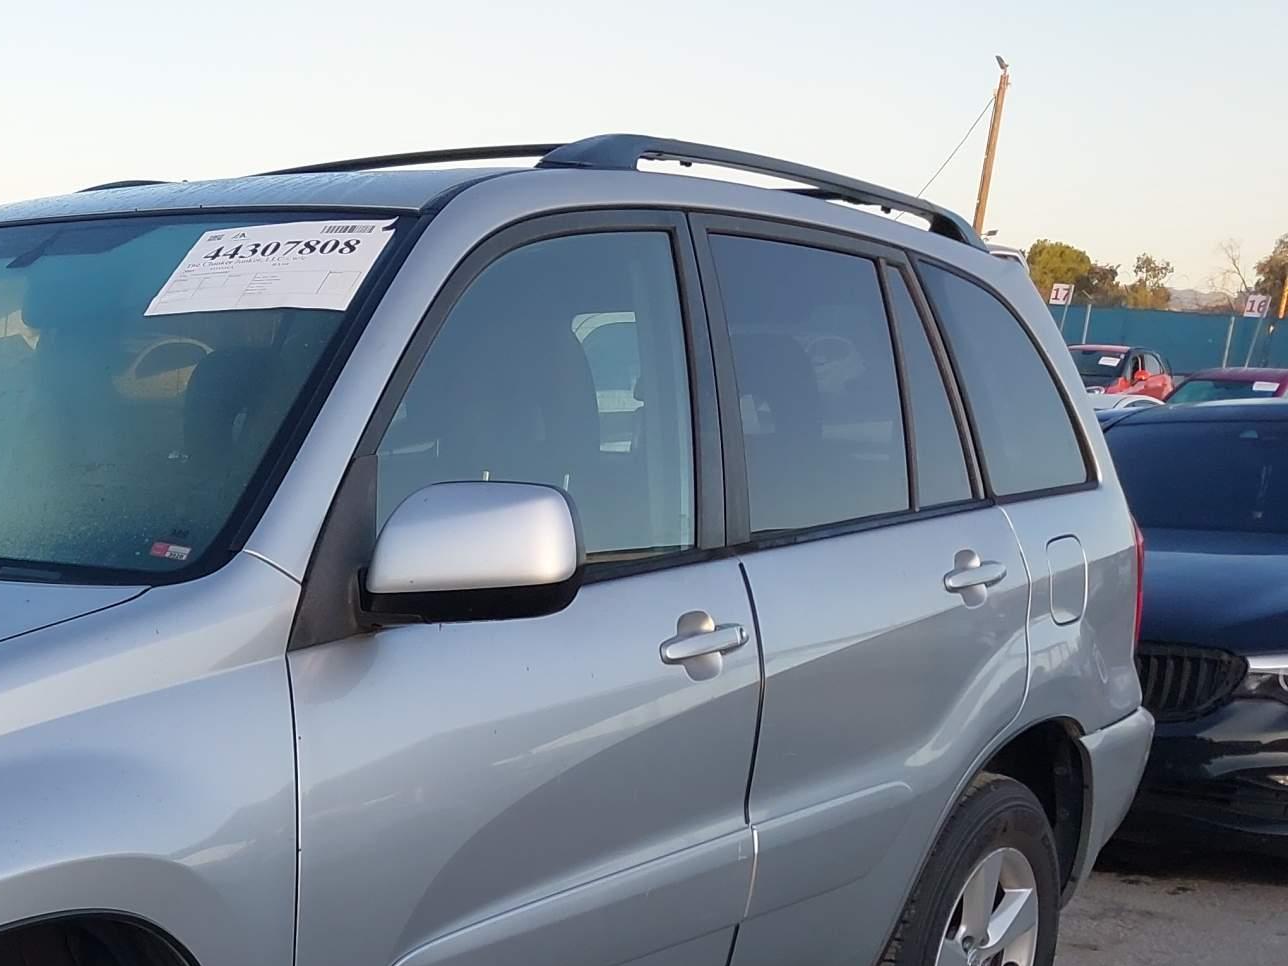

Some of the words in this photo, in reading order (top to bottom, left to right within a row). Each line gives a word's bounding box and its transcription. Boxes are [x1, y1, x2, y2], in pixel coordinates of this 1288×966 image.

[203, 239, 361, 260] 44307808
[1052, 288, 1070, 301] 17
[1246, 300, 1266, 313] 16
